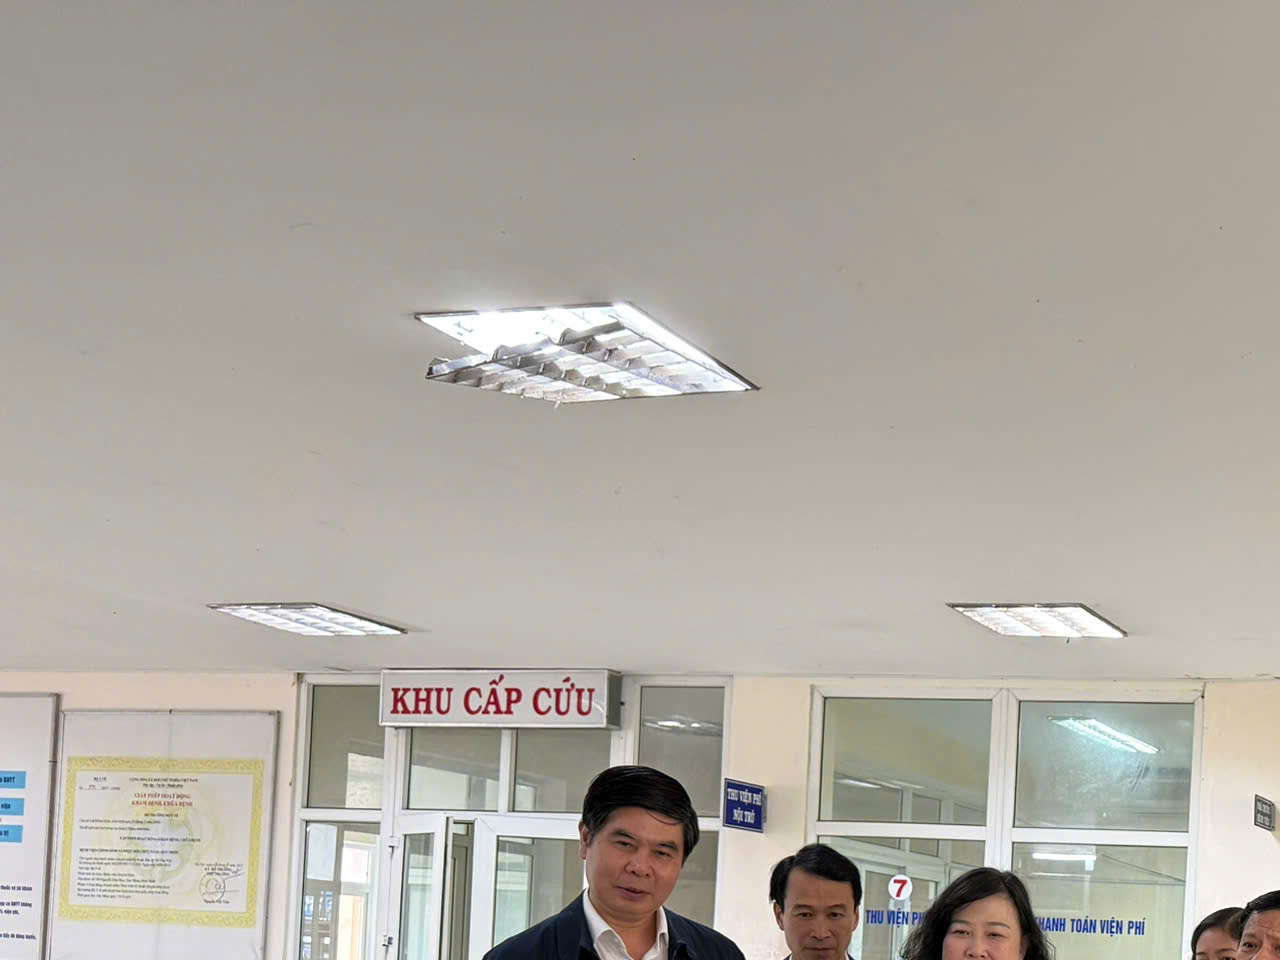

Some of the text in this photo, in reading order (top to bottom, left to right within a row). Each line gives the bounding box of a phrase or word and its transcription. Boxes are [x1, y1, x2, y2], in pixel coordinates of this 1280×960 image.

[390, 673, 595, 716] KHU CẤP CỨU
[893, 880, 908, 898] 7
[866, 910, 884, 924] THU
[887, 908, 909, 928] VIỆN
[1070, 915, 1097, 933] TOÁN
[1100, 916, 1124, 937] VIỆN
[1127, 917, 1146, 935] PHÍ
